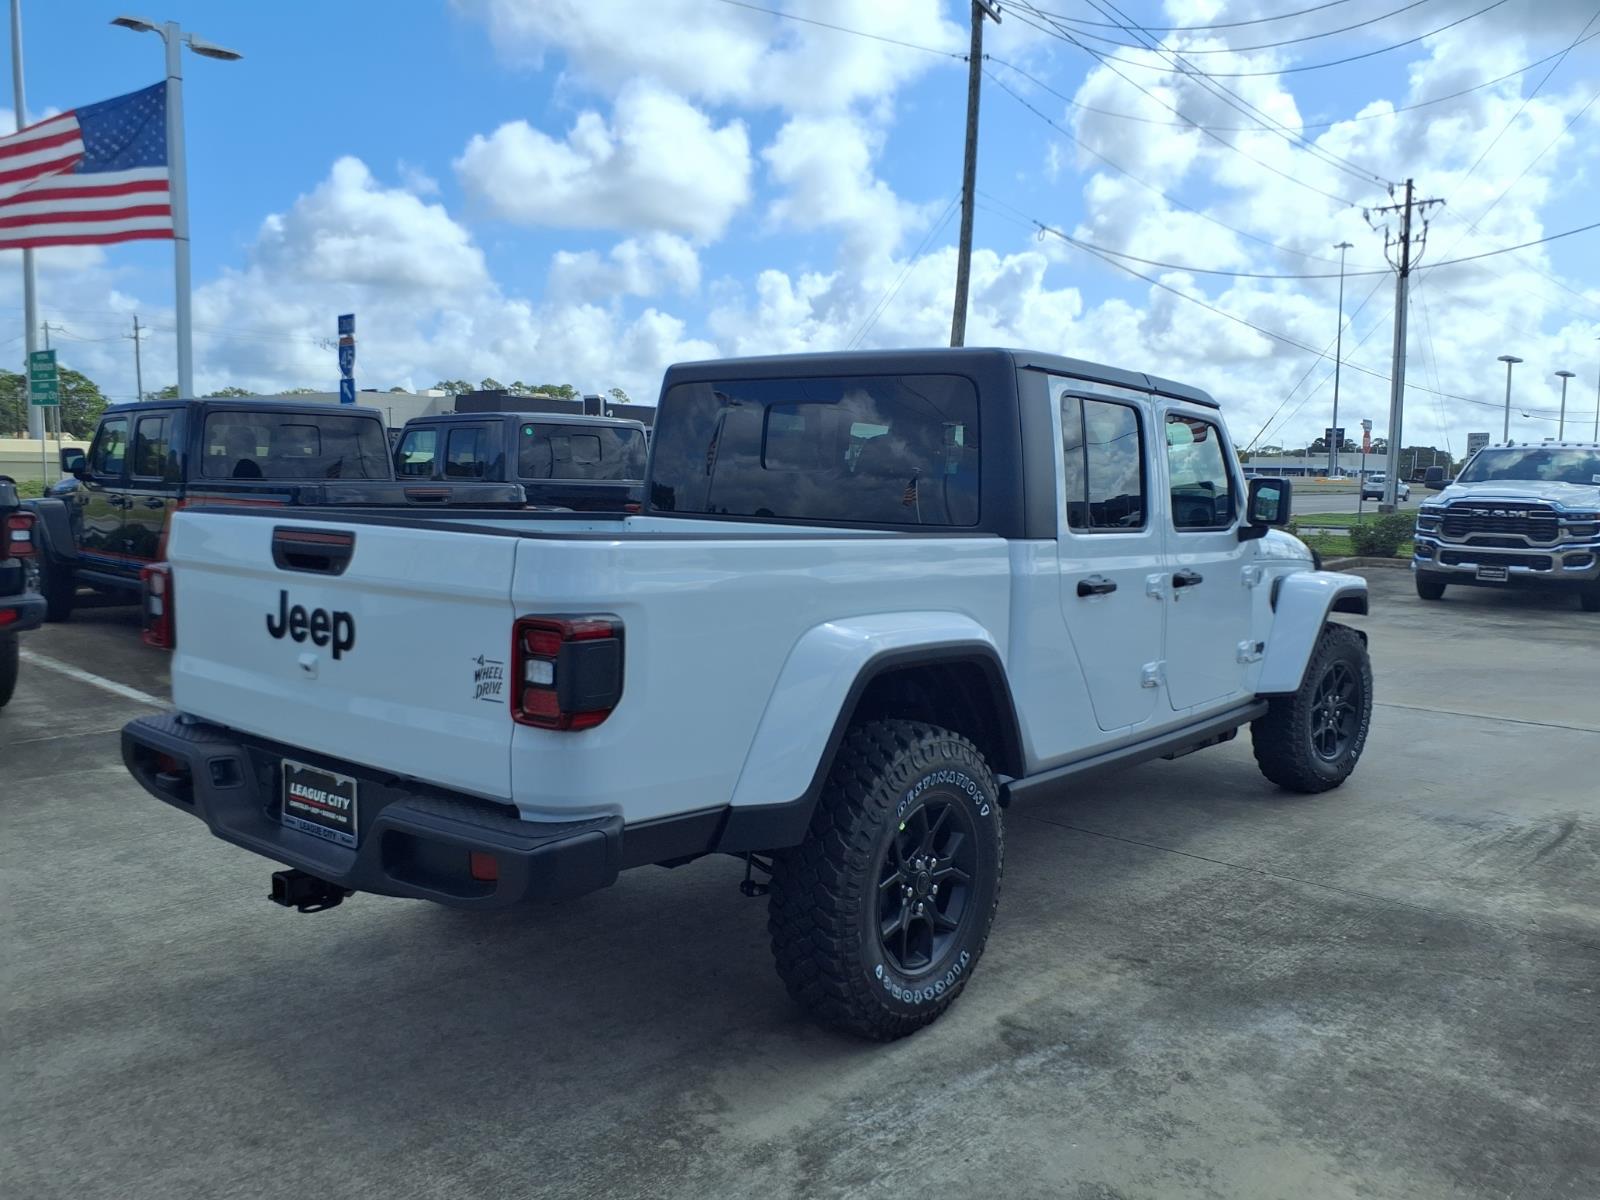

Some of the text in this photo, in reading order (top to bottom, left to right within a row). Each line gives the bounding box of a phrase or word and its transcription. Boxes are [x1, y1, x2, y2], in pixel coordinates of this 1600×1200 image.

[341, 350, 353, 369] 45
[1472, 508, 1527, 518] RAM
[266, 589, 356, 661] Jeep
[477, 653, 484, 666] 4
[475, 666, 503, 684] WHEEL
[475, 682, 502, 699] DRIVE
[290, 782, 350, 810] LEAGUE CITY
[897, 769, 985, 818] DESTINATION
